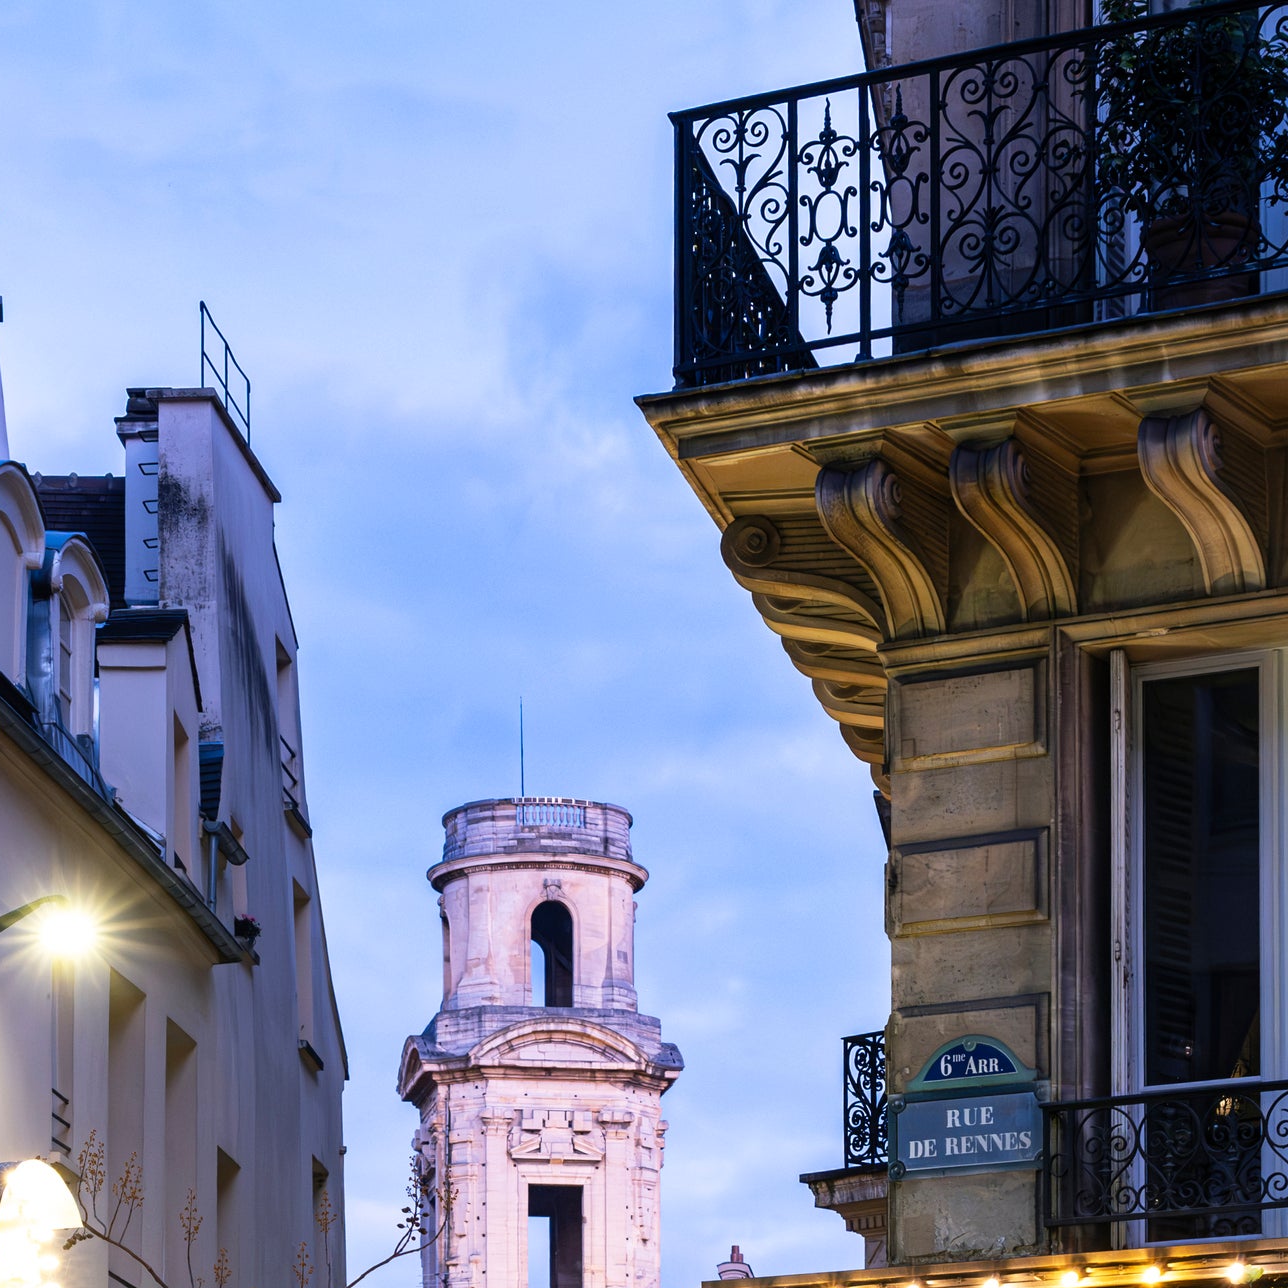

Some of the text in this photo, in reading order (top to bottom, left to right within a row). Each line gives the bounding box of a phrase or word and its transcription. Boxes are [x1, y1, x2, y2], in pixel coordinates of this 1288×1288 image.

[965, 1057, 1004, 1076] ARR.
[945, 1106, 994, 1129] RUE
[908, 1131, 1032, 1160] DE RENNES
